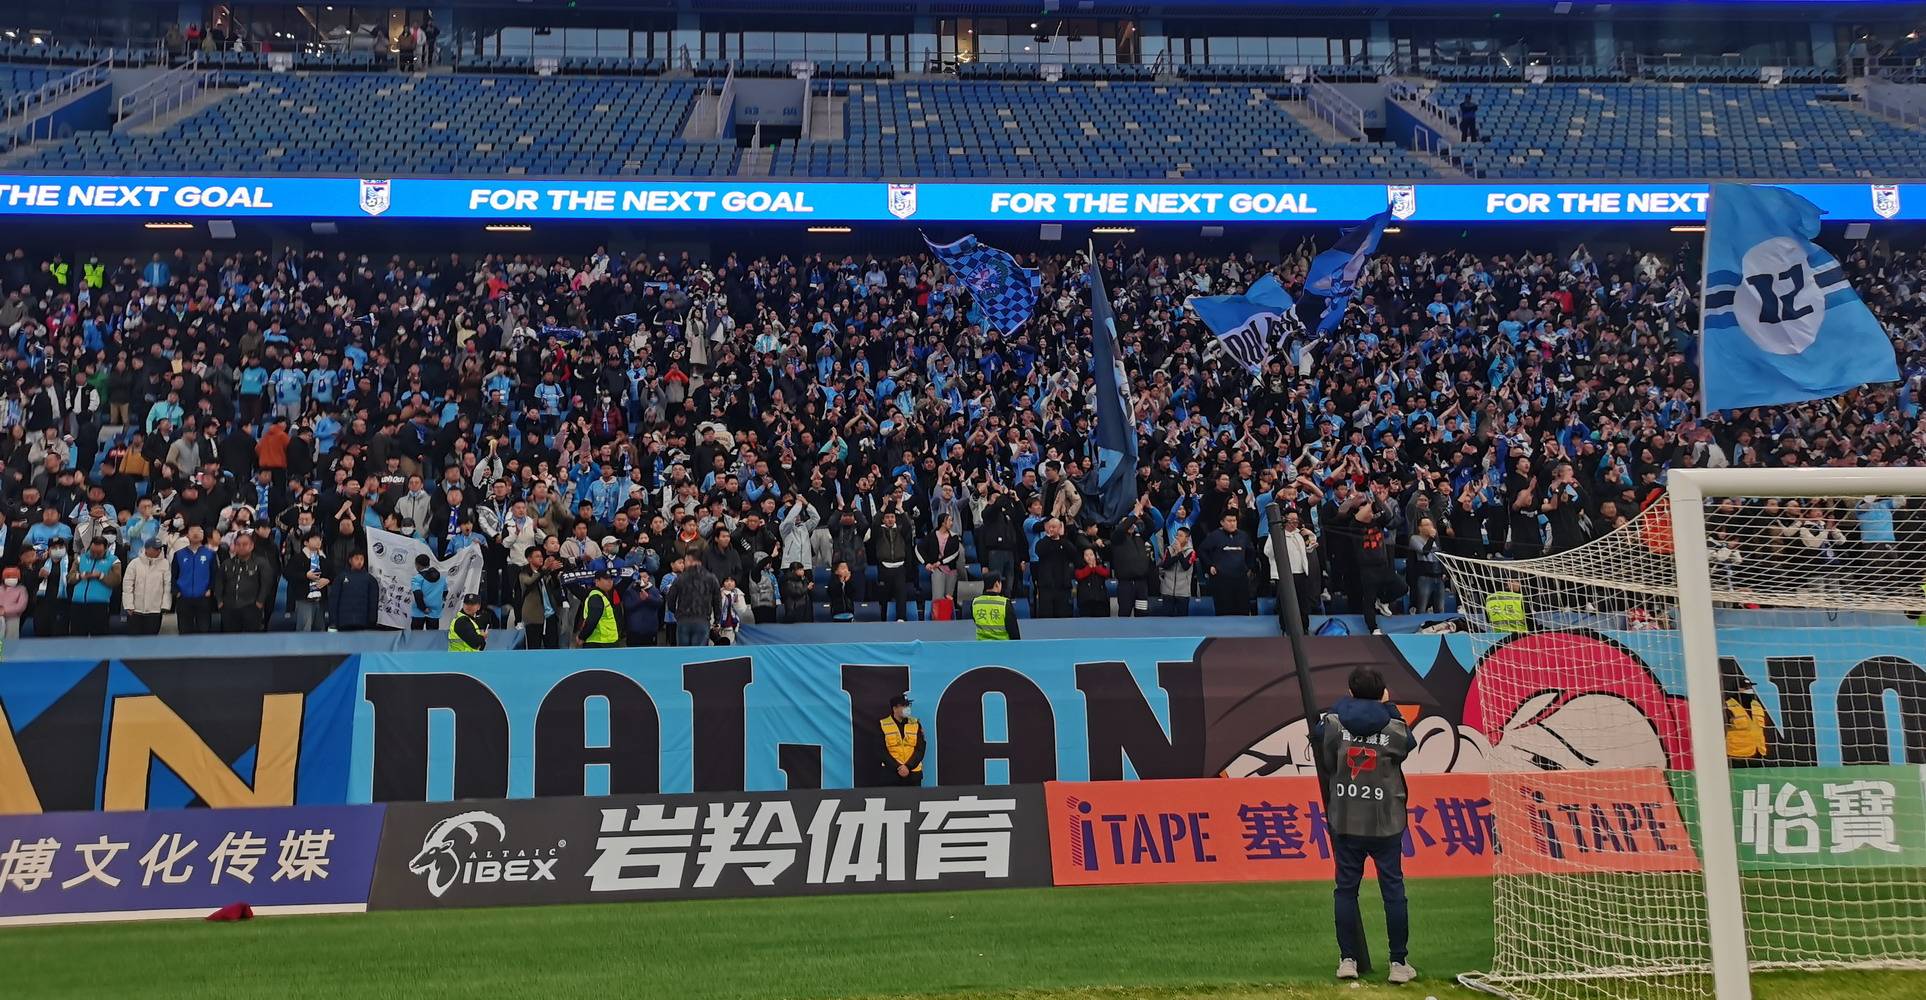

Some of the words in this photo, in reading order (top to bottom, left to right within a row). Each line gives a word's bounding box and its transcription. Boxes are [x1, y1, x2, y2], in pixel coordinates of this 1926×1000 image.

[67, 185, 169, 207] NEXT
[174, 186, 273, 208] GOAL
[469, 189, 539, 211] FOR
[547, 190, 616, 212] THE
[622, 191, 716, 212] NEXT
[721, 191, 813, 213] GOAL
[990, 192, 1056, 213] FOR
[1064, 193, 1128, 213] THE
[1134, 193, 1223, 213] NEXT
[1228, 193, 1318, 213] GOAL
[1486, 193, 1550, 213] FOR
[1557, 193, 1621, 213] THE
[1626, 192, 1710, 213] NEXT
[1745, 263, 1815, 324] 12
[976, 608, 1001, 621] 安保
[364, 656, 1206, 803] DALIAN
[1336, 783, 1384, 800] 0029
[1741, 780, 1902, 855] 怡寶
[469, 848, 556, 859] ALTAIC
[583, 796, 1017, 892] 岩羚体育
[0, 829, 335, 893] 博文化传媒
[462, 858, 558, 884] IBEX
